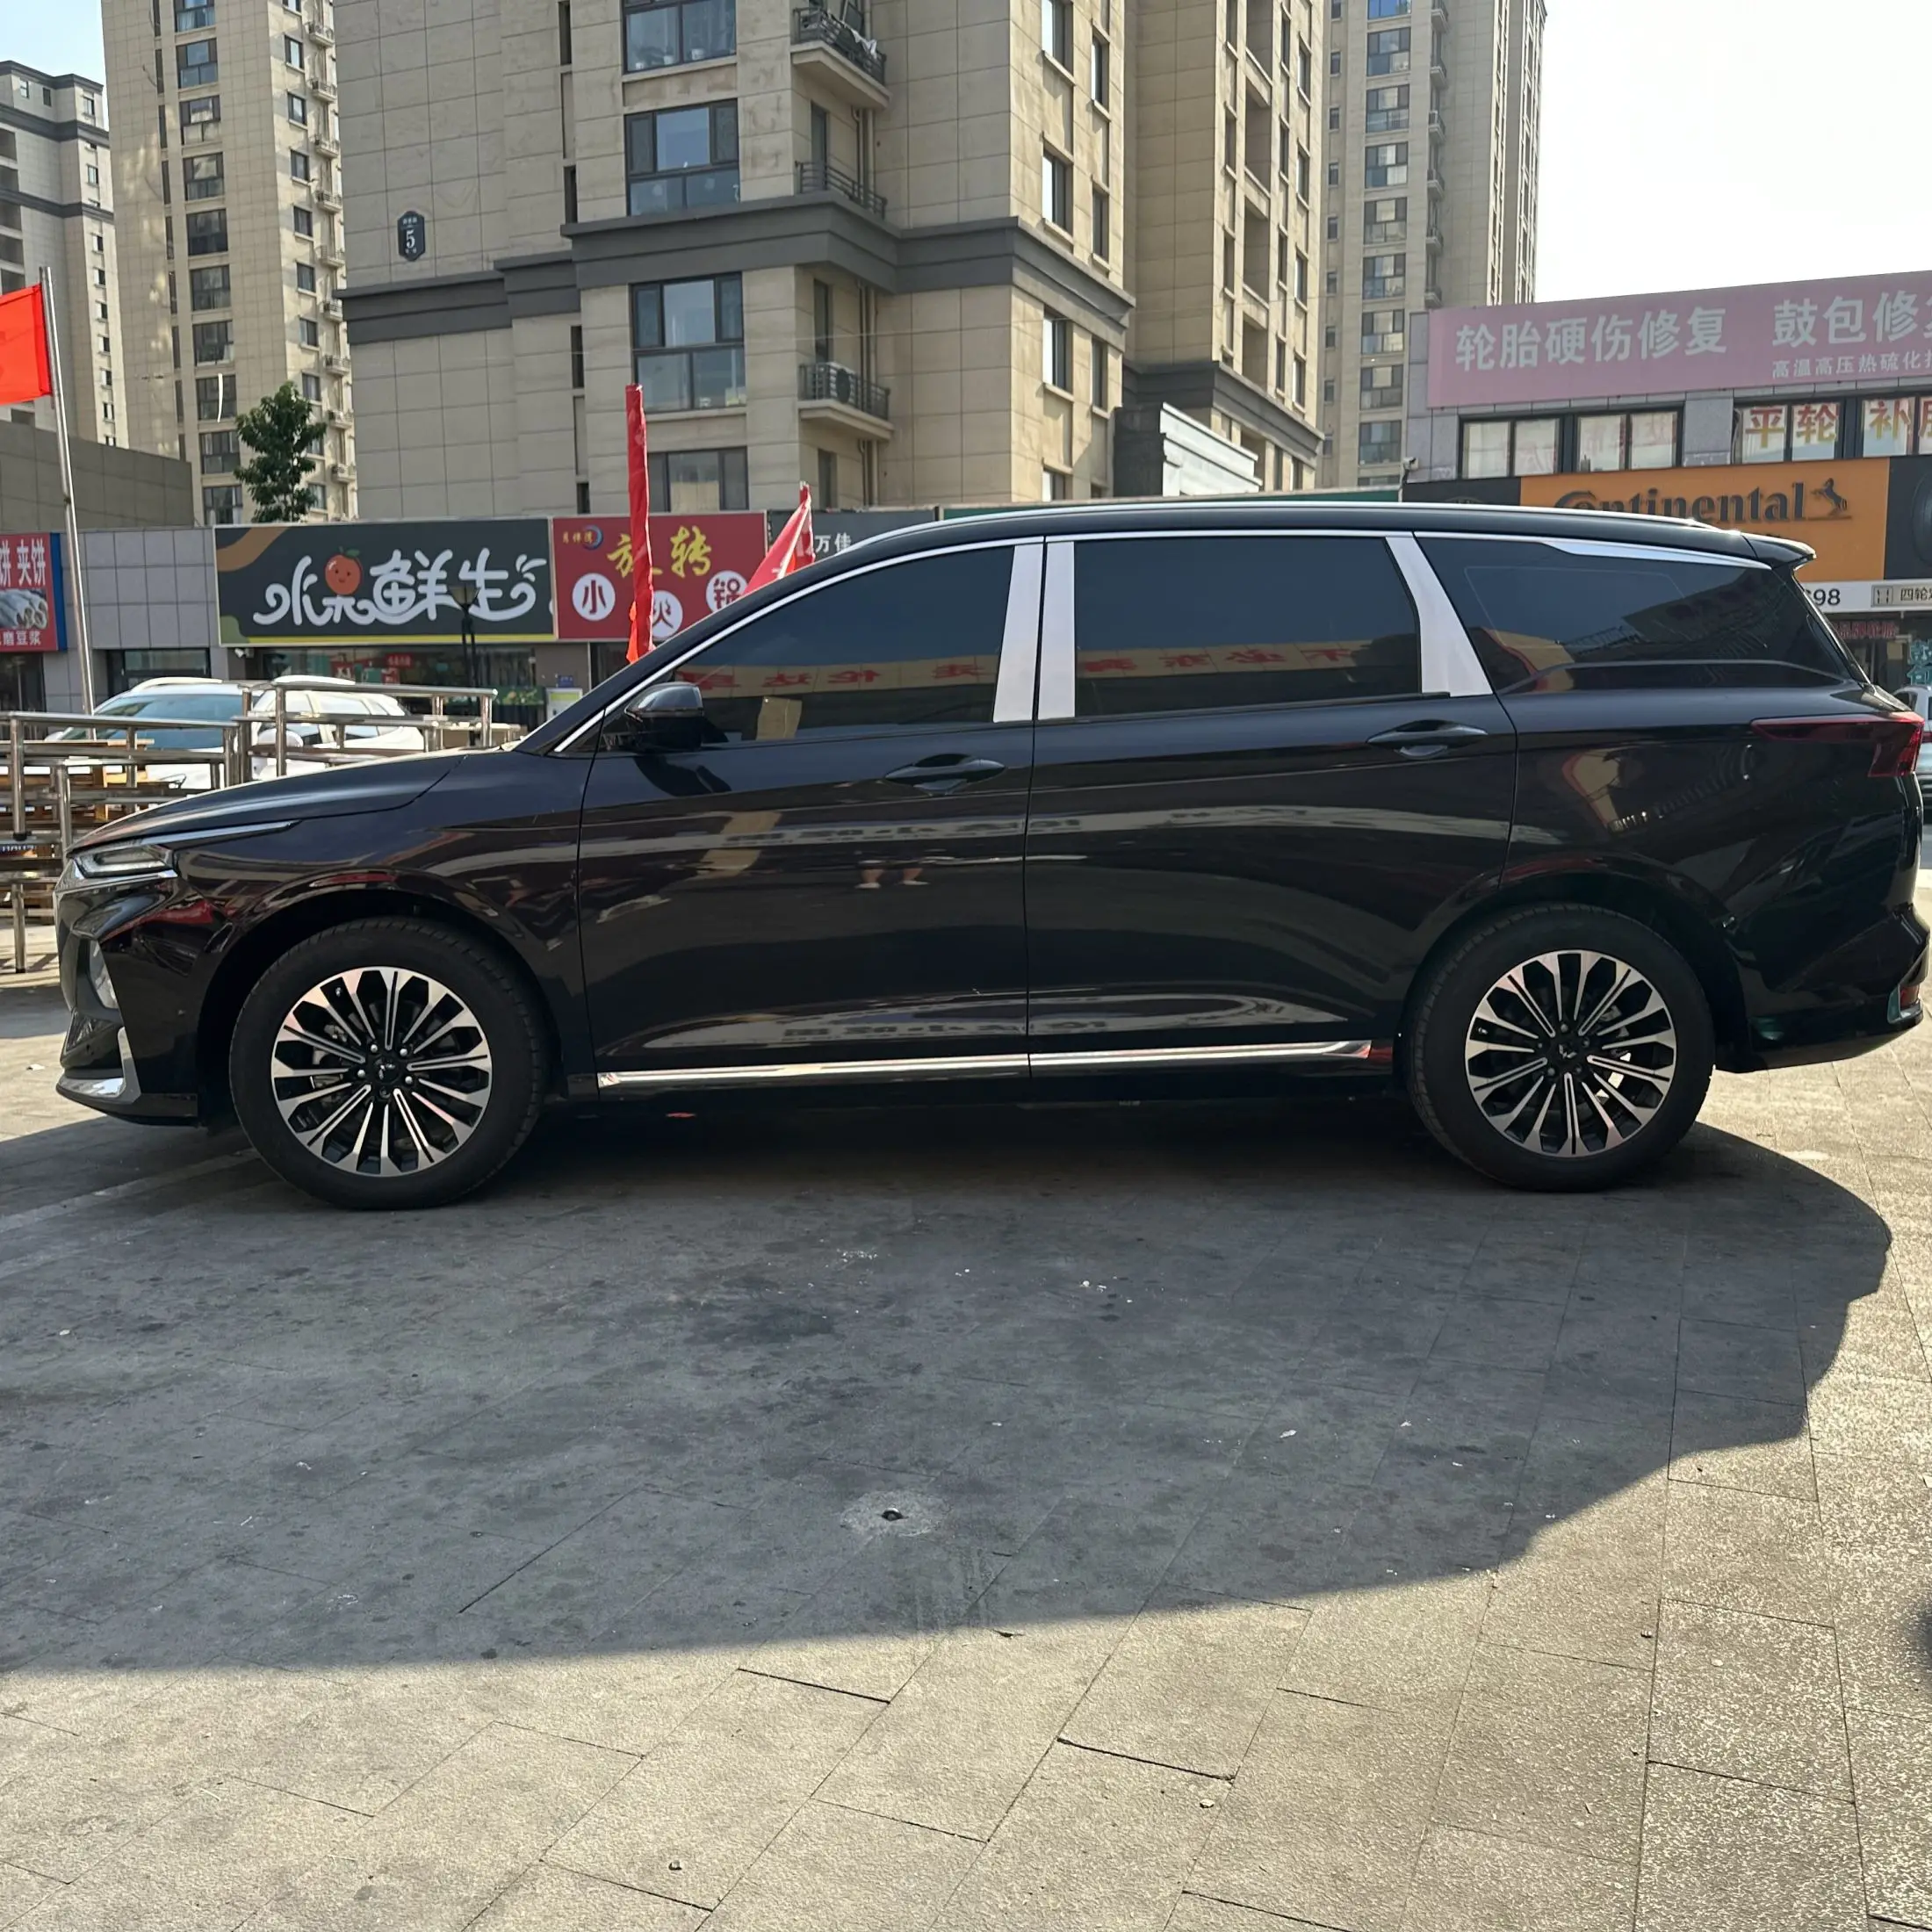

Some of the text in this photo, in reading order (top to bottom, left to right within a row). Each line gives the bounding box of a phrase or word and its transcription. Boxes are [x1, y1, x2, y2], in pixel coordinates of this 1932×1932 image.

[407, 229, 415, 249] 5
[1454, 306, 1727, 372] 轮胎硬伤修复
[1553, 480, 1806, 522] tinental
[17, 537, 46, 587] 夹饼
[1807, 588, 1841, 606] 98
[0, 631, 41, 646] 磨豆浆
